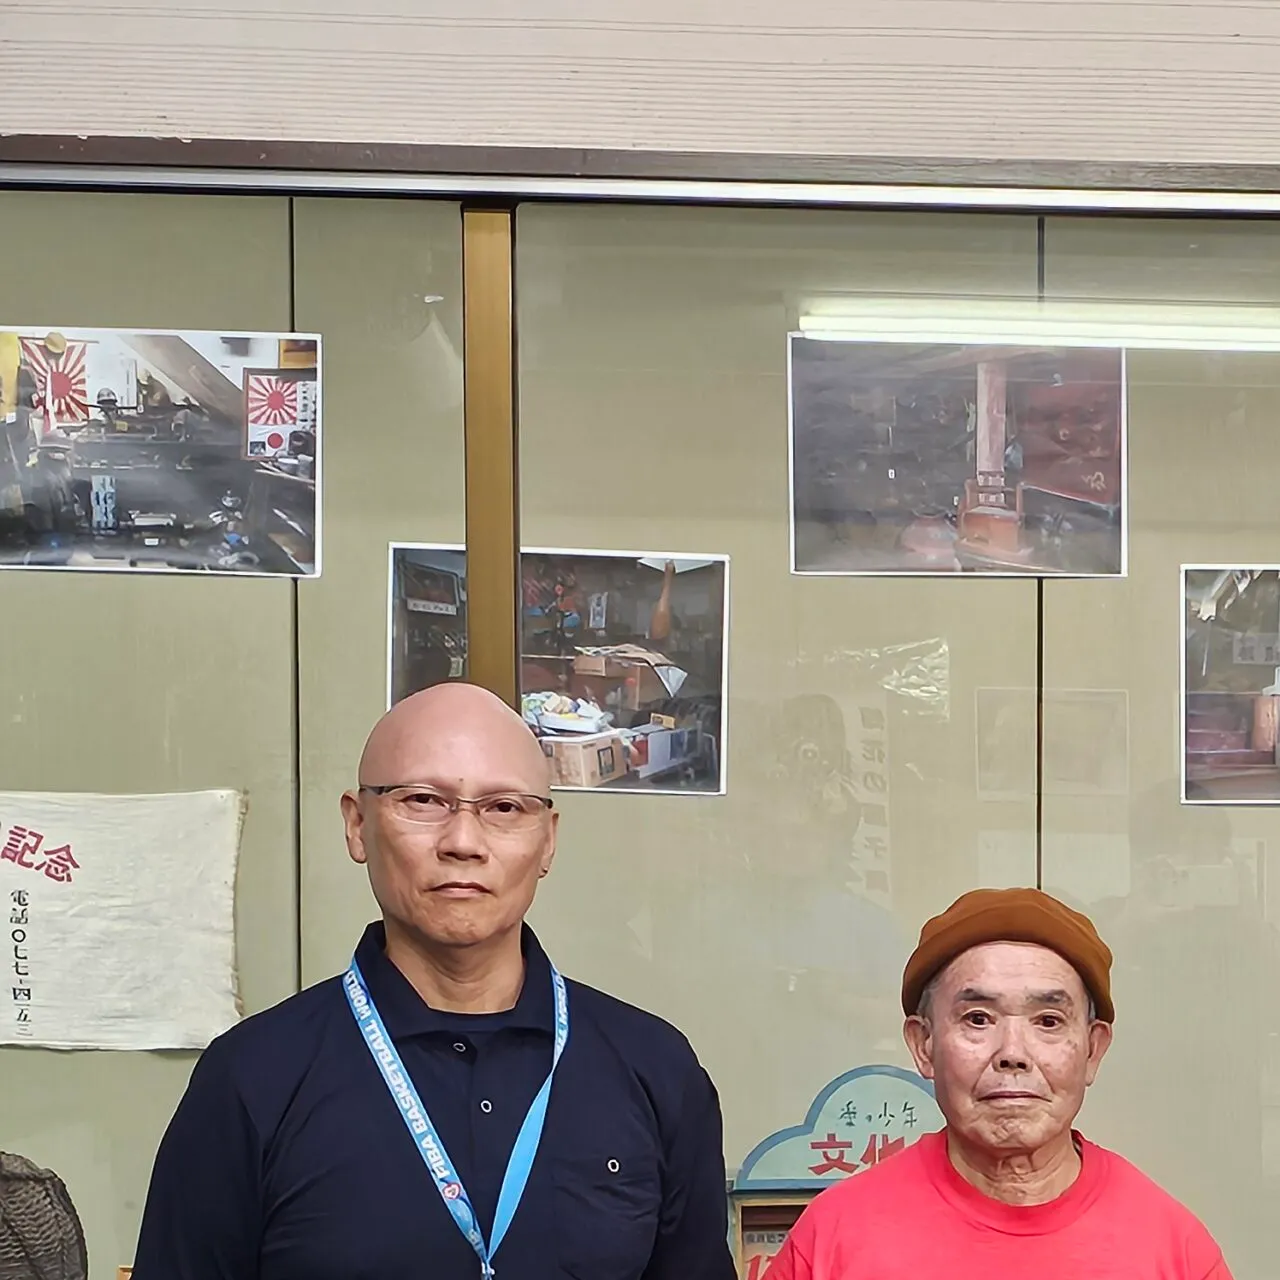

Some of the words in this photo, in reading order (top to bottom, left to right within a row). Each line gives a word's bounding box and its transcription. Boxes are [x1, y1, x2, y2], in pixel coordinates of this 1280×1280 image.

[1, 825, 81, 883] 記念
[364, 1018, 428, 1135] BASKETBALL
[420, 1133, 451, 1180] FIBA
